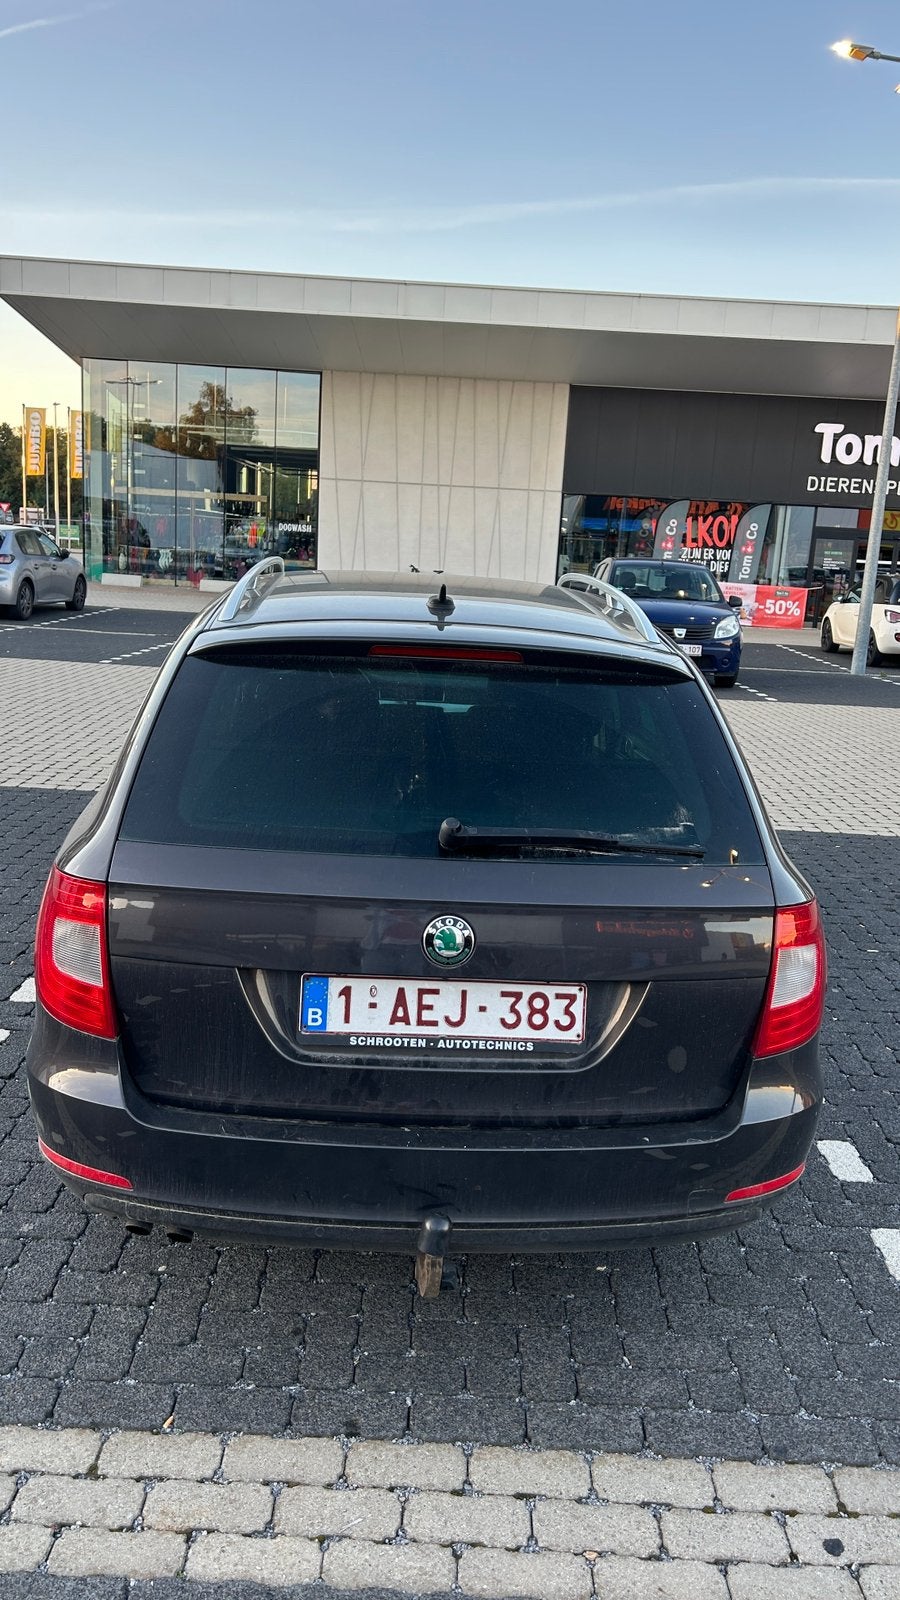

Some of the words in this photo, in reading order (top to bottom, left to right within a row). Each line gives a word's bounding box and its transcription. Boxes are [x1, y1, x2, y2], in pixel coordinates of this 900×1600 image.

[29, 411, 42, 472] JUMBO
[806, 476, 900, 496] DIERENP
[278, 522, 312, 533] DOGWASH
[665, 518, 678, 536] Co
[745, 522, 759, 540] Co
[681, 547, 702, 560] ZIJN
[703, 548, 714, 560] ER
[738, 555, 753, 580] Tom
[758, 599, 801, 617] -50%
[307, 1007, 323, 1026] B
[338, 984, 578, 1032] 1-AEJ-383
[349, 1036, 427, 1048] SCHROOTEN
[437, 1040, 534, 1052] AUTOTECHNICS
